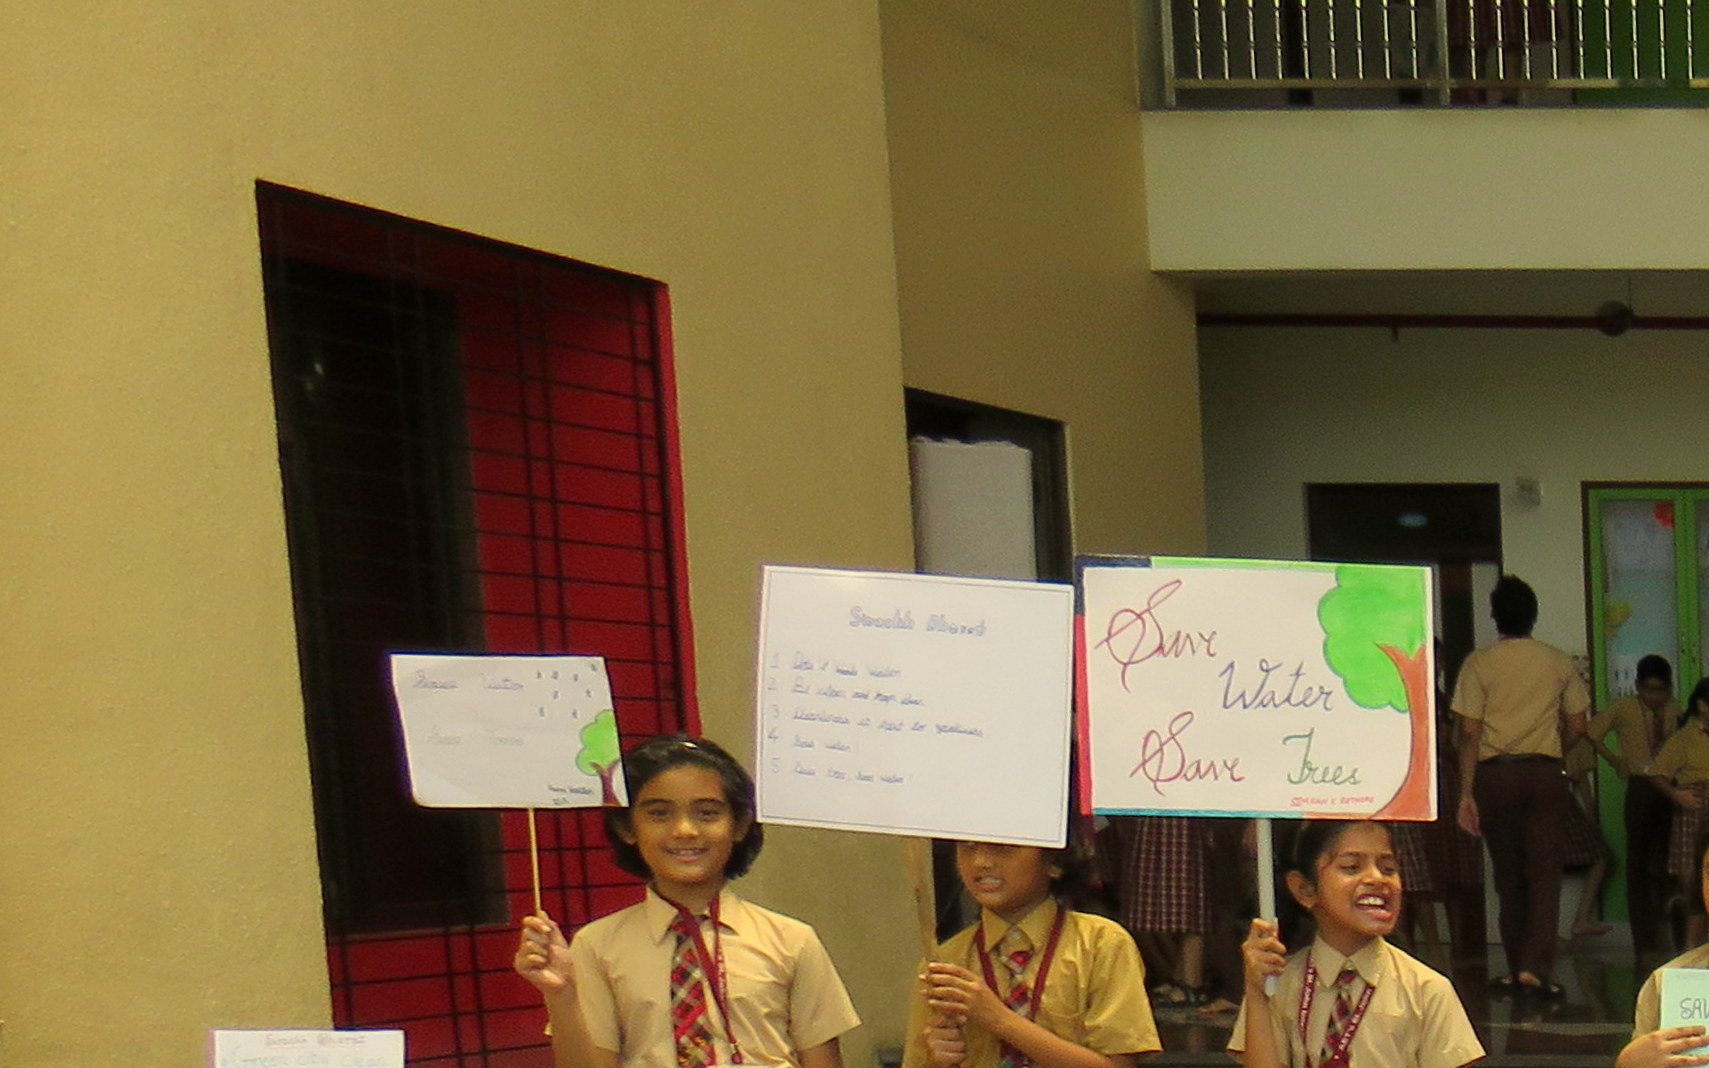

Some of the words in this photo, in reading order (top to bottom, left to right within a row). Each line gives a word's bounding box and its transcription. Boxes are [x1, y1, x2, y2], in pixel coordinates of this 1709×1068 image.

[1094, 578, 1218, 694] Save
[1218, 658, 1335, 712] Water
[1129, 710, 1245, 797] Save
[1282, 727, 1362, 786] Trees
